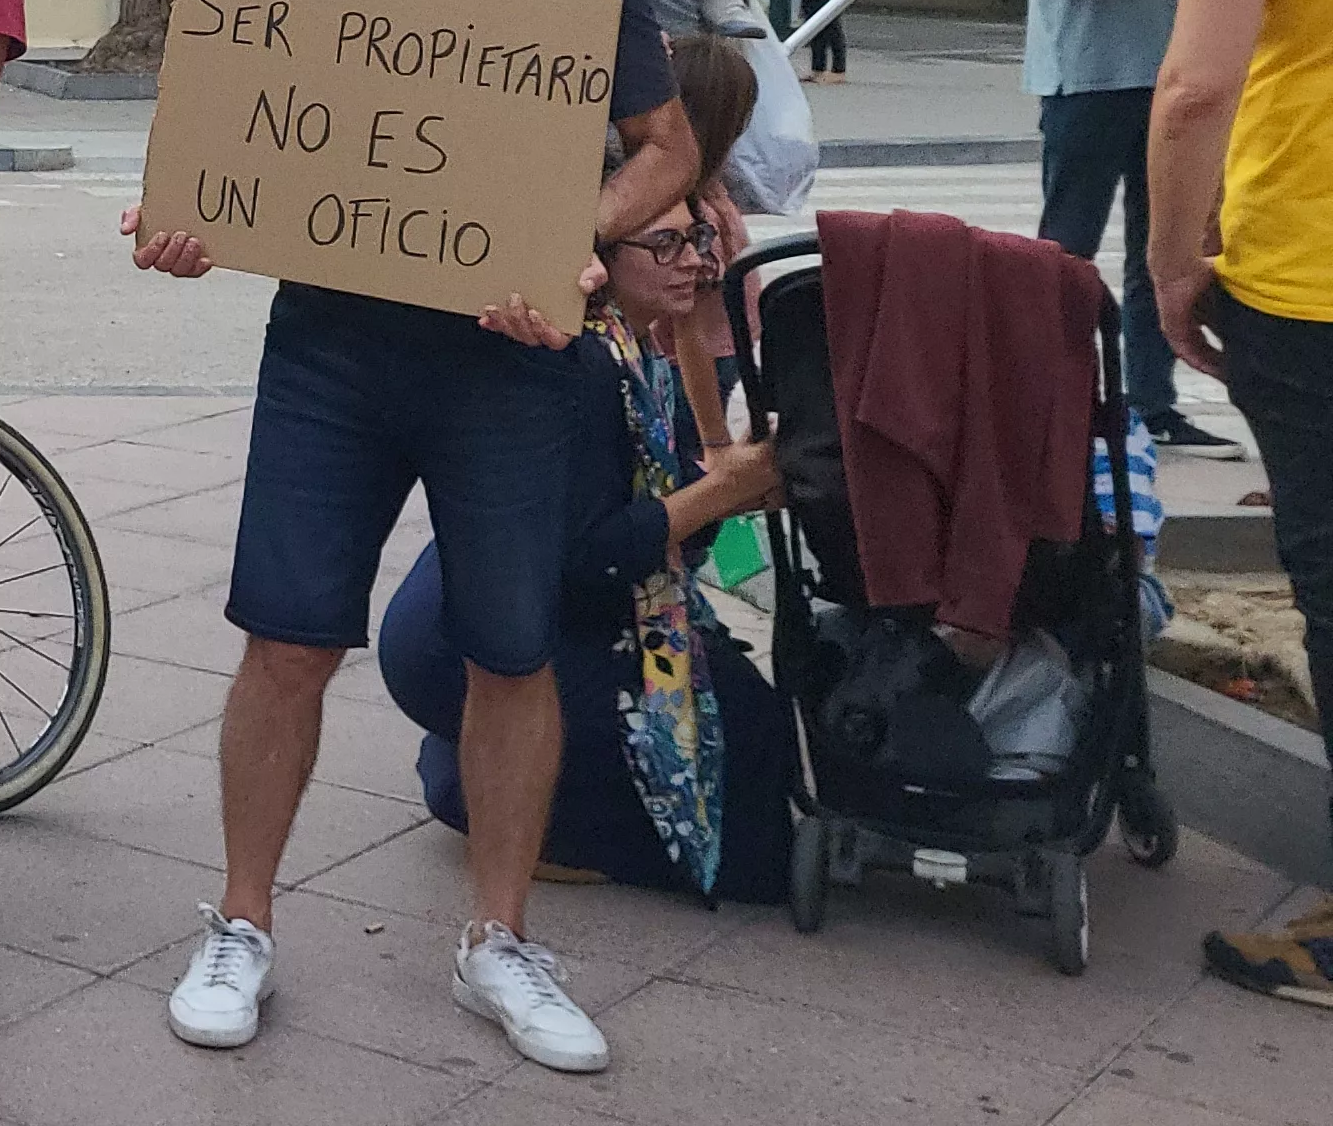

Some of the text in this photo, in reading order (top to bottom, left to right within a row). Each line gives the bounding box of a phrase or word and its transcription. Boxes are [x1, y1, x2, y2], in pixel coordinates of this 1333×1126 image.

[335, 10, 611, 106] PROPIETARIO
[245, 84, 448, 174] NO ES
[196, 168, 492, 267] UN OFICIO
